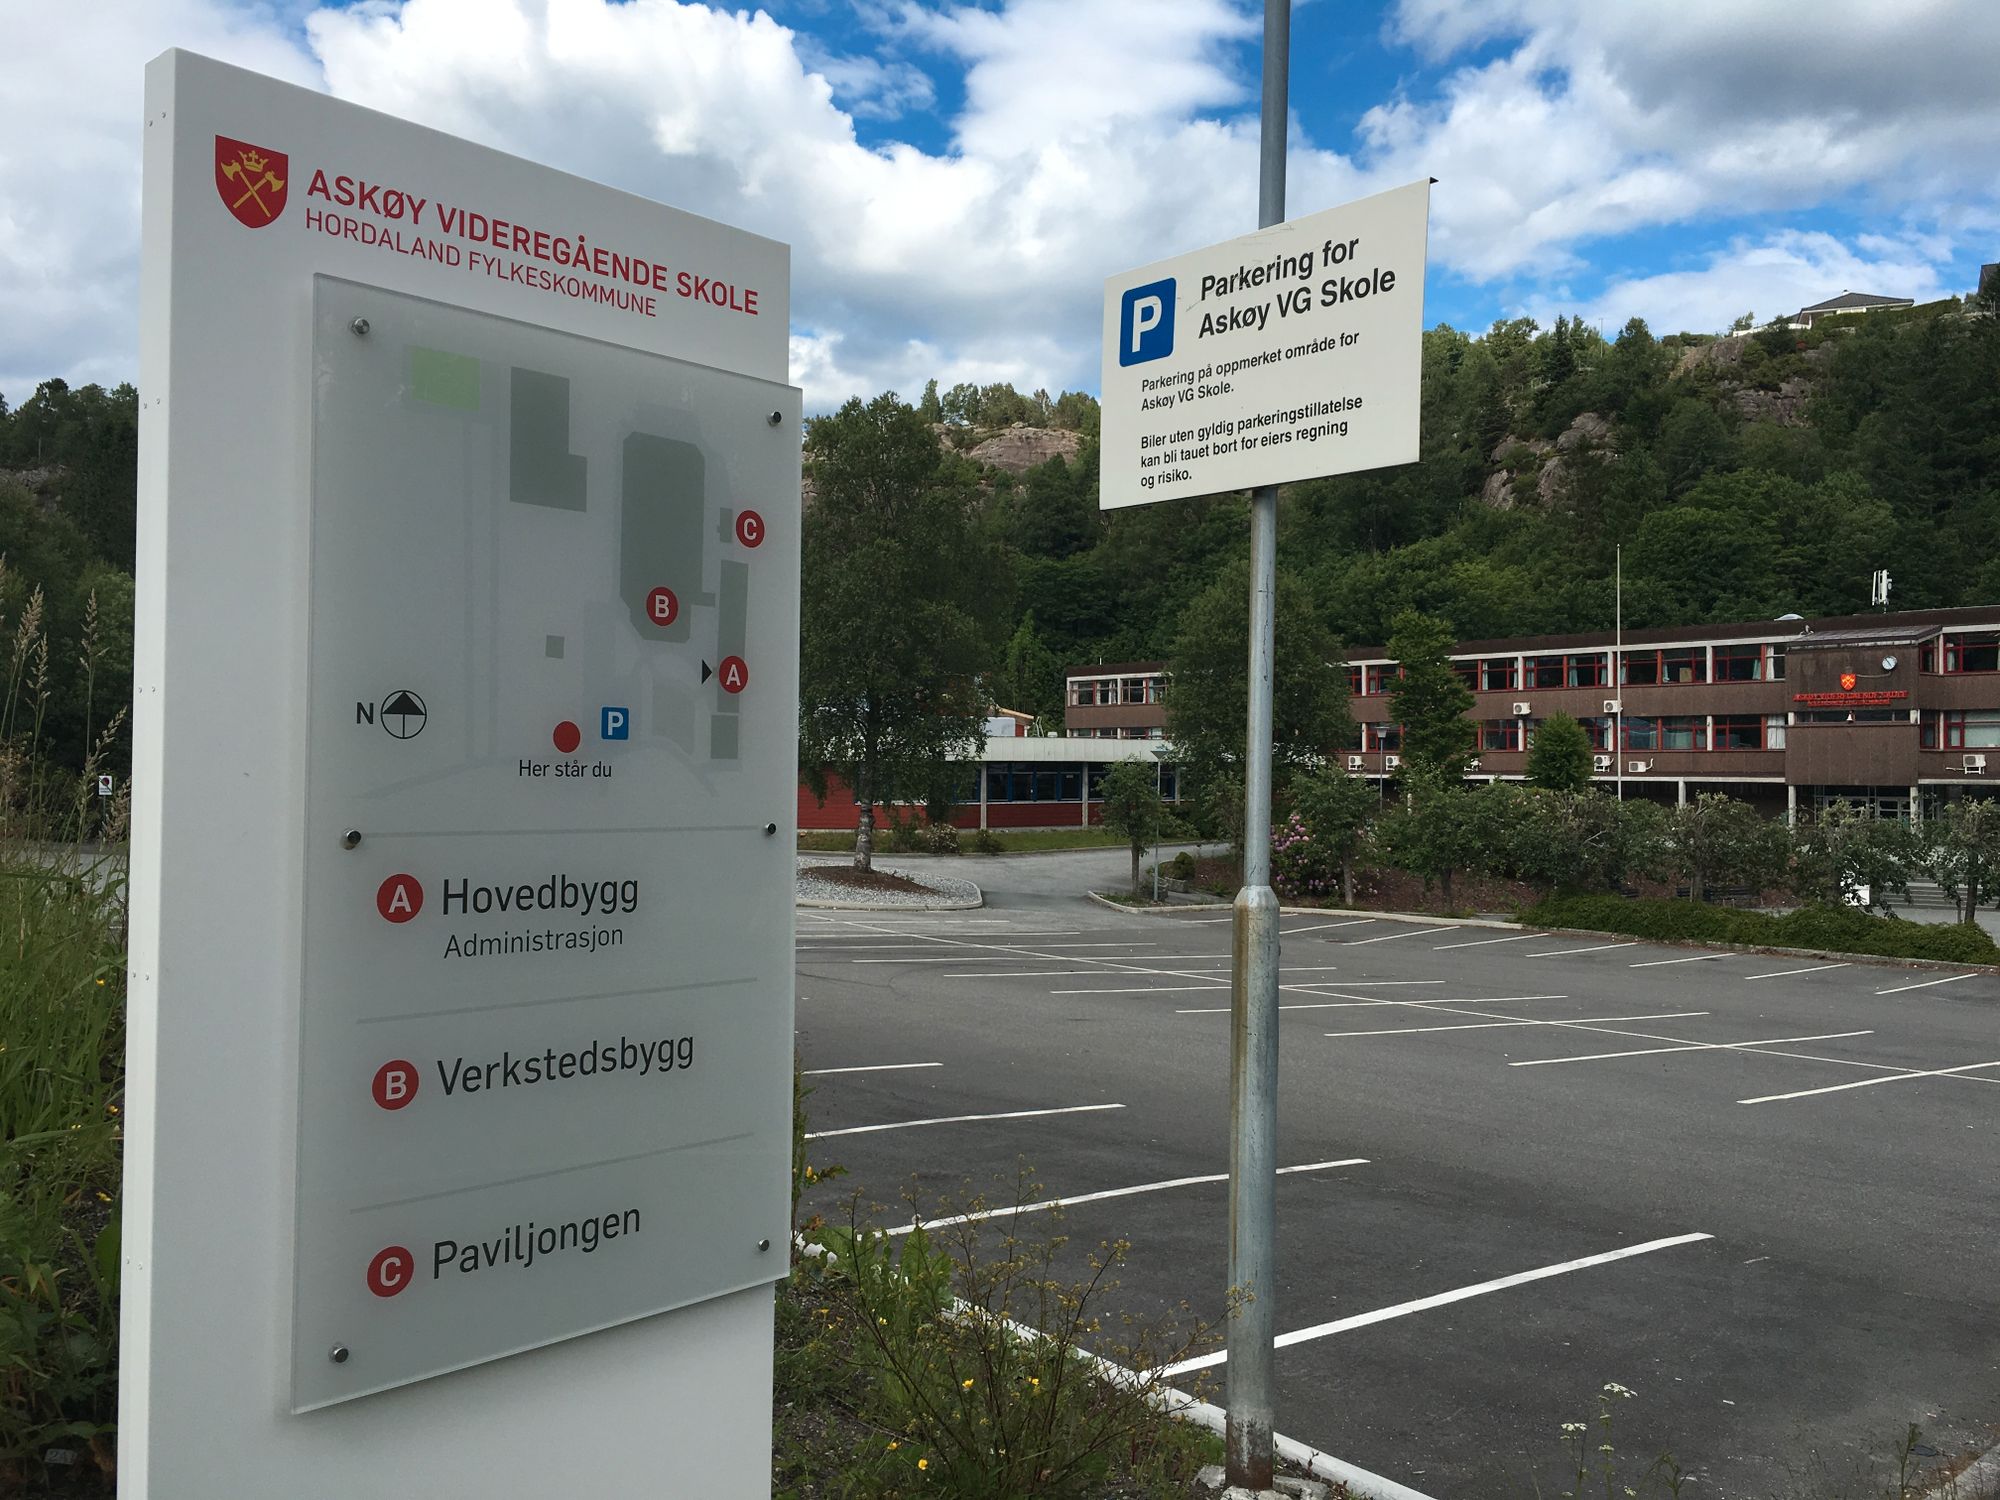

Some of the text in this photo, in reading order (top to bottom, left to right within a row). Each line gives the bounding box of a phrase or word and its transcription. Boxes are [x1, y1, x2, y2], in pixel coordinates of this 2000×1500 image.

[306, 208, 656, 317] HORDALAND FYLKESKOMMUNE
[307, 169, 758, 315] ASKØY VIDEREGÅENDE SKOLE
[1201, 237, 1359, 300] Parkering for
[1132, 295, 1162, 353] P
[1199, 267, 1395, 338] Askøy VG Skole
[1142, 332, 1359, 392] Parkering på oppmerket område for
[1141, 381, 1234, 411] Askøy VG Skole.
[1141, 395, 1362, 449] Biler uten gyldig parkeringstillatelse
[1141, 420, 1348, 468] kan bli tauet bort for eiers regning
[1141, 469, 1192, 488] og risiko.
[743, 518, 757, 540] C
[655, 595, 669, 618] B
[726, 664, 740, 687] A
[357, 702, 374, 724] N
[607, 711, 623, 736] P
[519, 759, 612, 777] Her står du
[388, 875, 639, 915] A Hovedbygg
[443, 925, 623, 958] Administrasjon
[385, 1035, 694, 1099] B Verkstedsbygg
[380, 1207, 640, 1287] C Paviljongen
